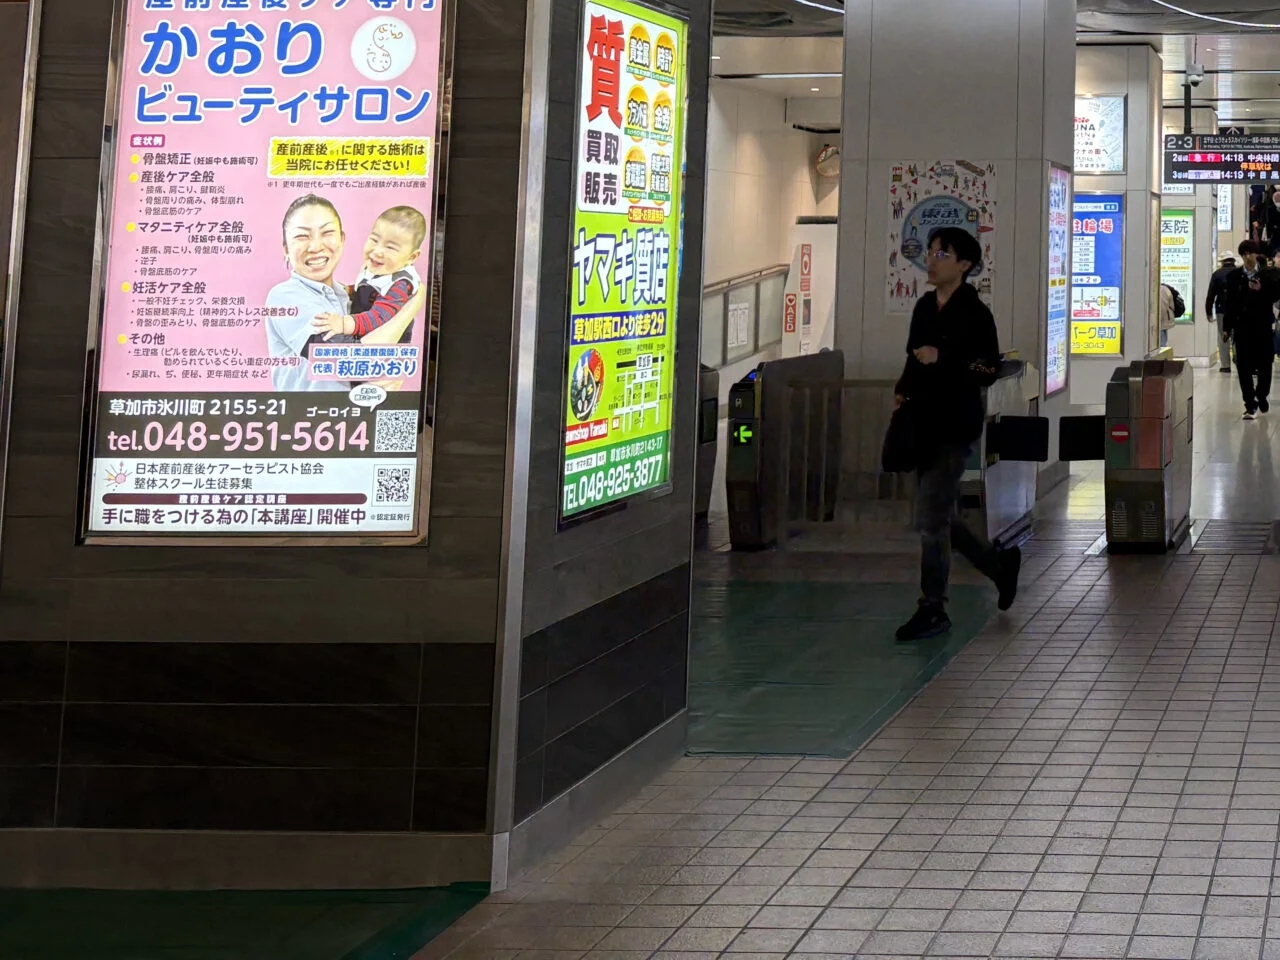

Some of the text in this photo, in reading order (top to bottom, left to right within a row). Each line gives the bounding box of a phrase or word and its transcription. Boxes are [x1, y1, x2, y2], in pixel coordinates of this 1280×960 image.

[140, 21, 323, 75] かおり
[656, 46, 673, 74] 時計
[586, 12, 625, 129] 質
[137, 84, 431, 124] ビューティサロン
[132, 136, 164, 146] 症状例
[586, 129, 619, 166] 買取
[143, 152, 191, 165] 骨盤矯正
[1221, 153, 1244, 162] 14:18
[141, 170, 215, 183] 産後ケア全般
[1221, 171, 1244, 180] 14:19
[584, 171, 618, 206] 販売
[138, 221, 244, 234] マタニティケア全般
[573, 228, 670, 306] ヤマキ質店
[132, 281, 206, 294] 妊活ケア全般
[573, 309, 666, 343] 草加駅西口より徒歩2分
[787, 307, 795, 331] AED
[129, 333, 166, 345] その他
[251, 371, 269, 379] など
[313, 360, 417, 376] 代表 萩原かおり
[108, 398, 287, 416] 草加市氷川町 2155-21
[306, 406, 361, 417] ゴーロイヨ
[134, 477, 253, 490] 整体スクール生徒募集
